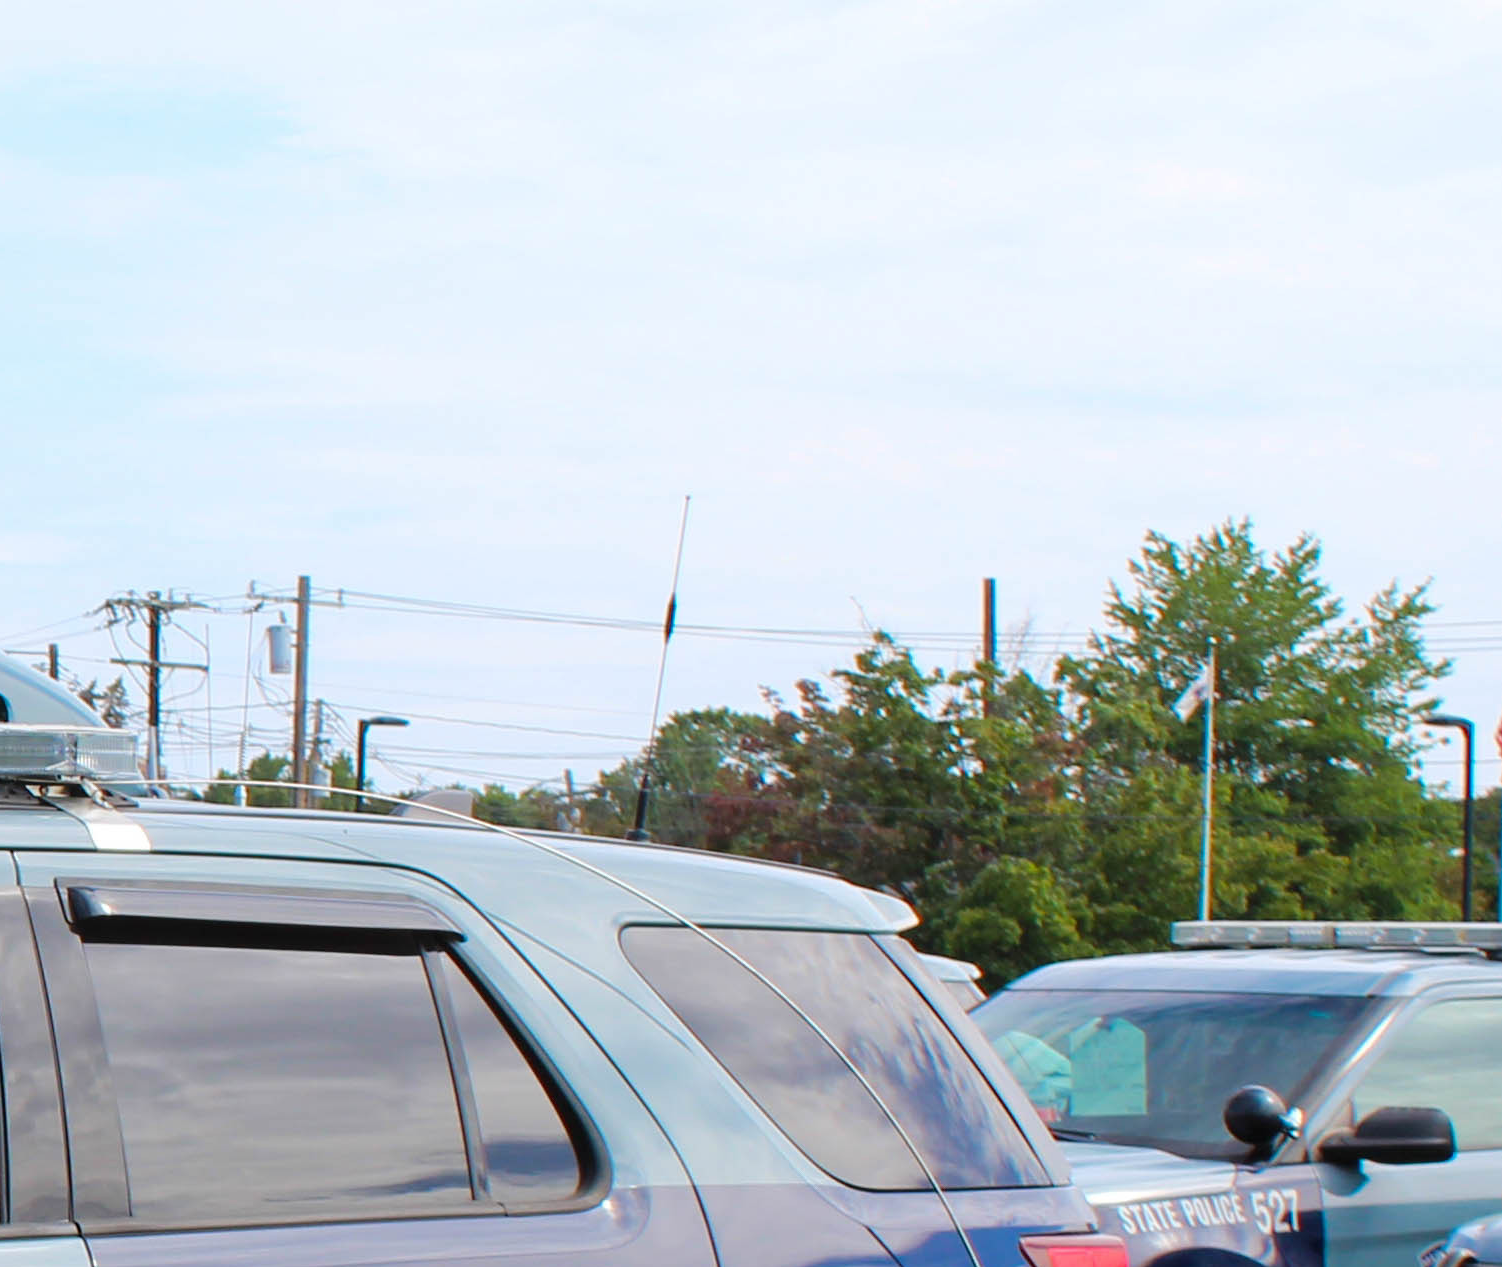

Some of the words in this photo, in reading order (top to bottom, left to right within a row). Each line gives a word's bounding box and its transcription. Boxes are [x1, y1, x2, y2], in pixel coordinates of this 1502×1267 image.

[1116, 1200, 1183, 1235] STATE
[1179, 1190, 1247, 1227] POLICE
[1251, 1188, 1300, 1234] 527
